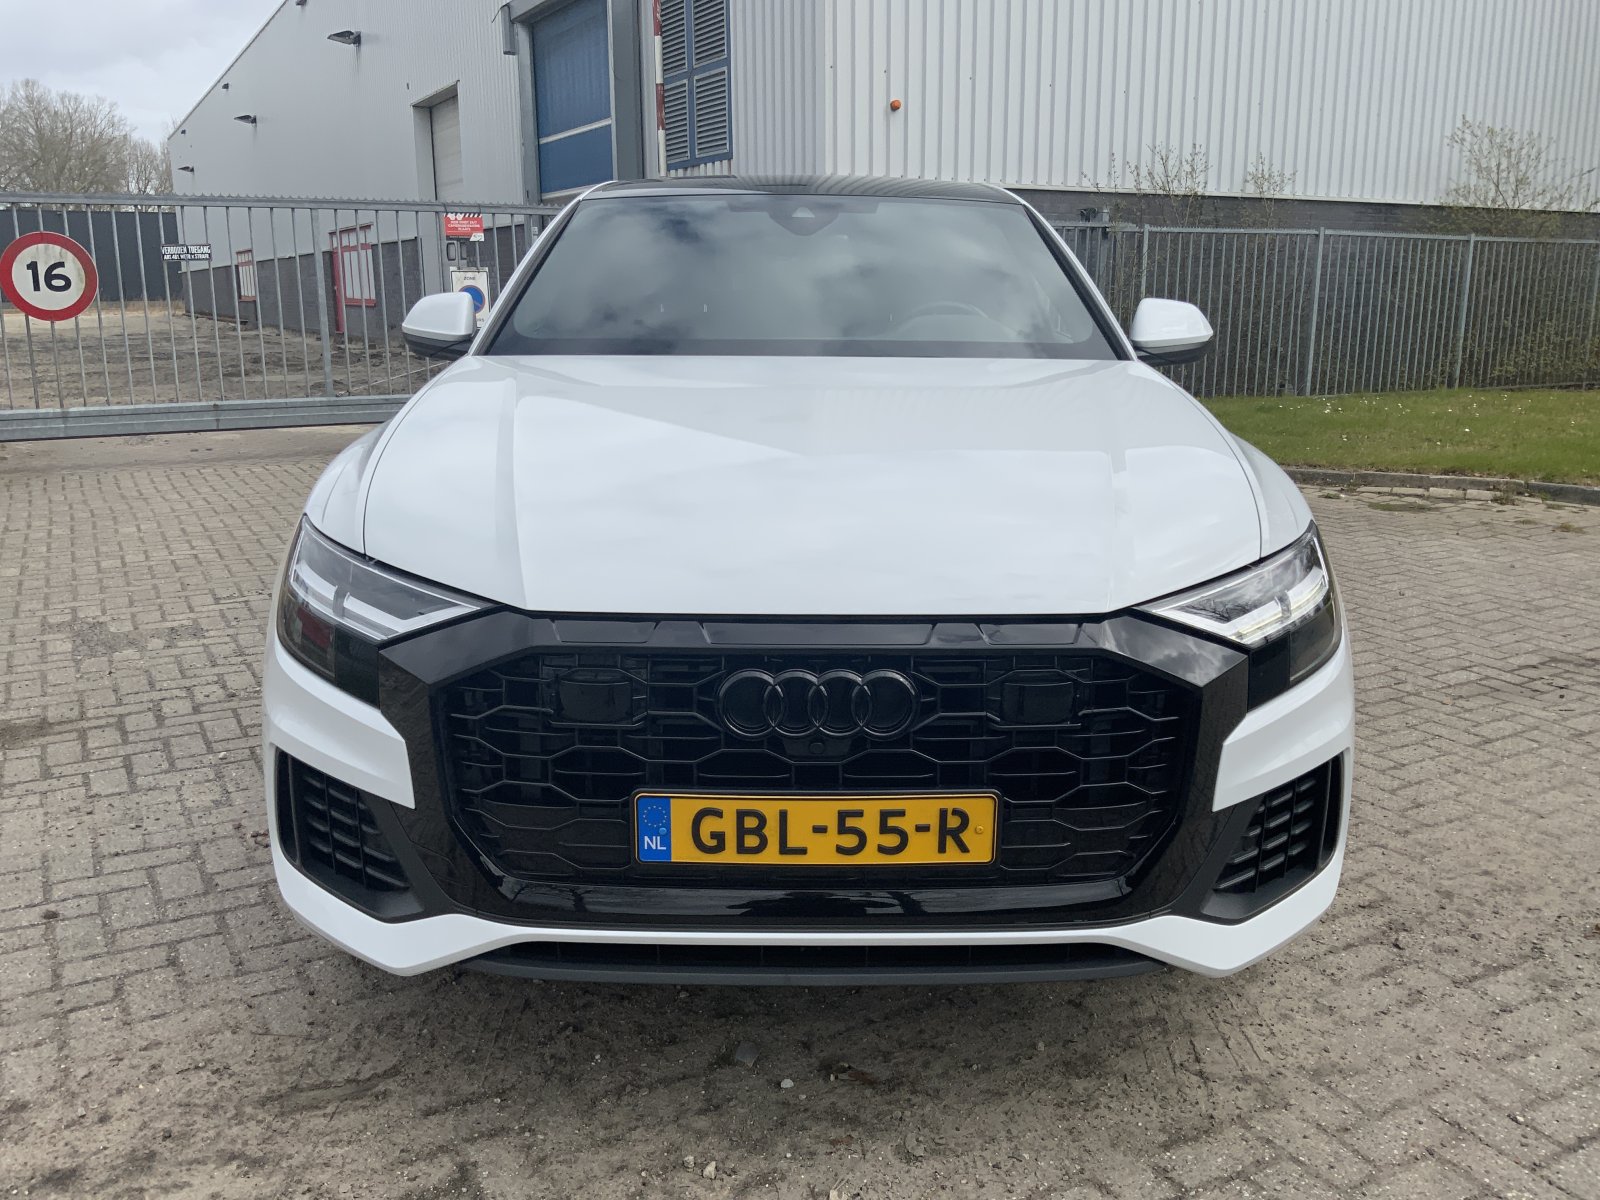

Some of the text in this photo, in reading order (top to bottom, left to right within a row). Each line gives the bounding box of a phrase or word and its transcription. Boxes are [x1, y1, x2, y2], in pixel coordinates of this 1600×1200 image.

[161, 245, 211, 254] VERBODEN TOEGANG
[26, 260, 72, 292] 16
[644, 835, 667, 850] NL
[691, 807, 970, 855] GBL-55-R
